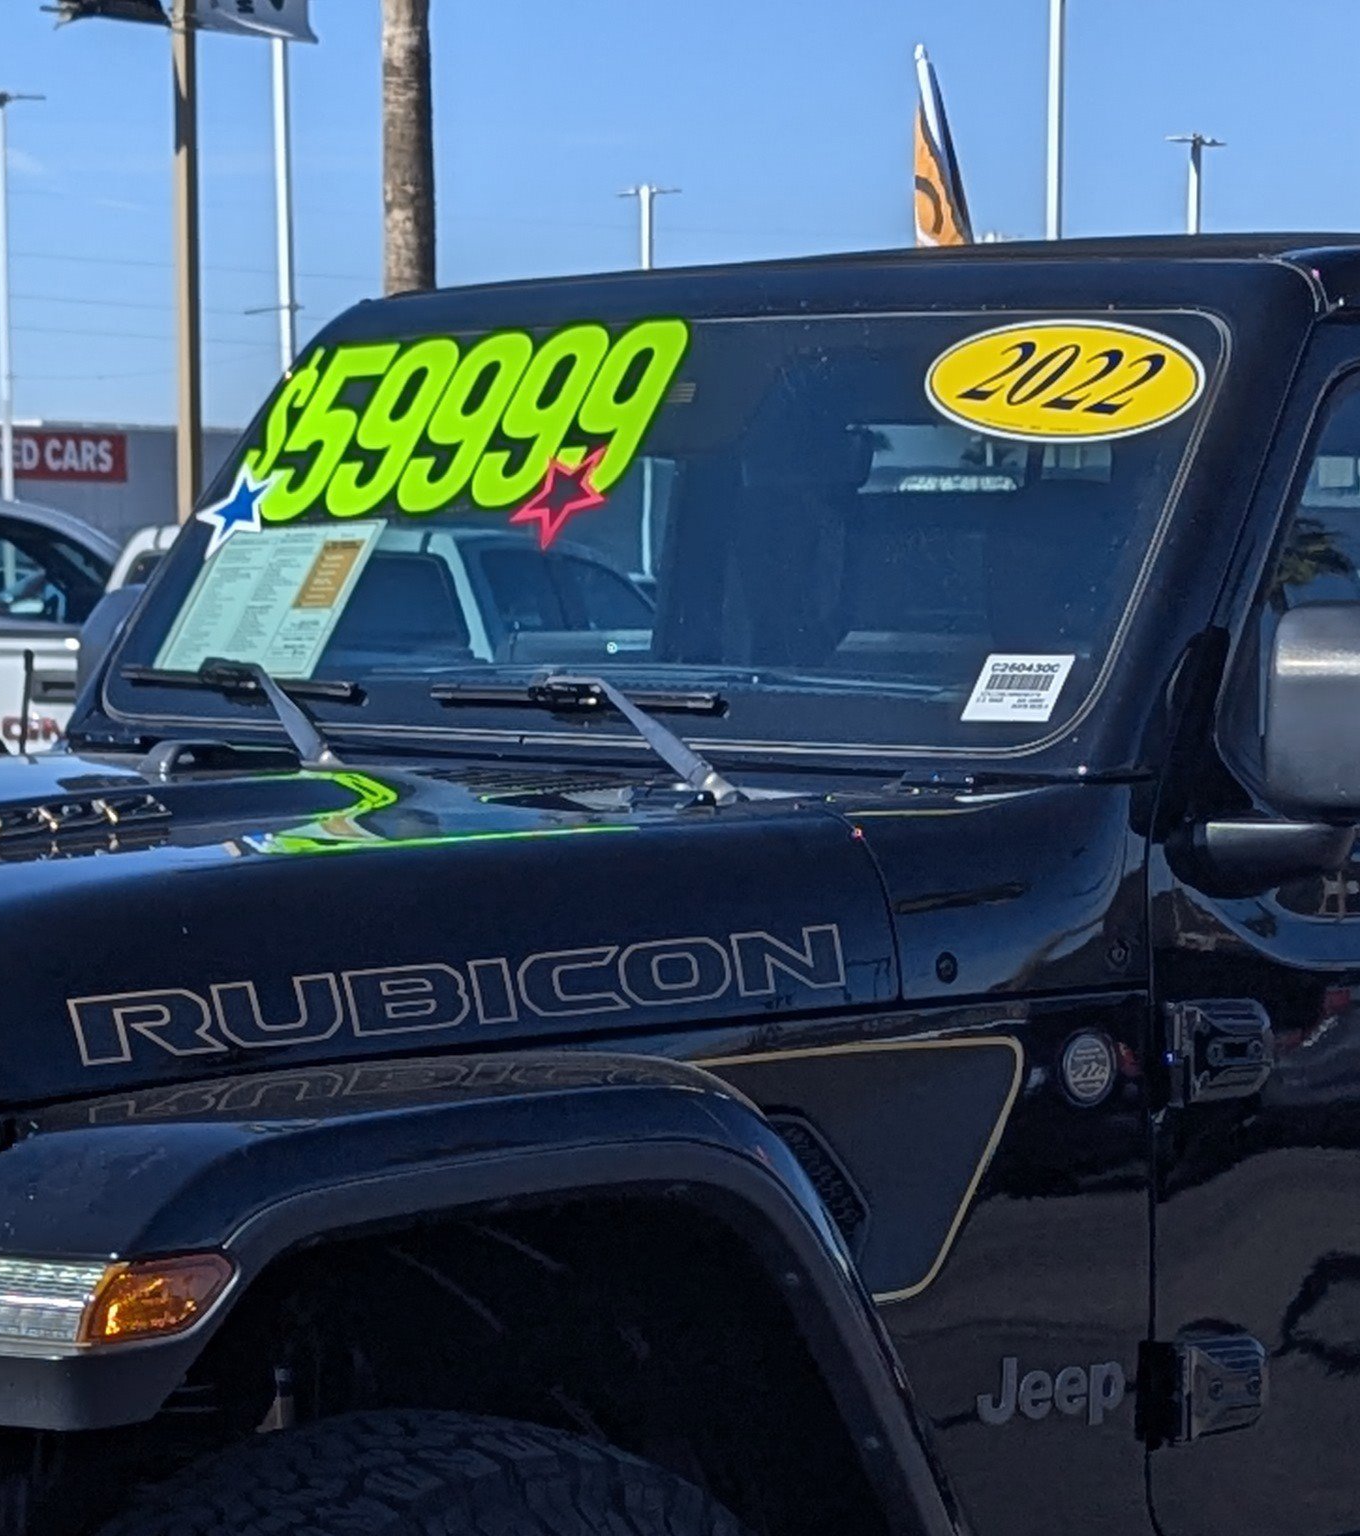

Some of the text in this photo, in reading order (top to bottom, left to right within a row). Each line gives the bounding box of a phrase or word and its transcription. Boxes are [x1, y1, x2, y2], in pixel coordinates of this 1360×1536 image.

[955, 341, 1166, 416] 2022
[45, 439, 113, 474] CARS
[242, 318, 690, 523] $59999
[67, 924, 847, 1066] RUBICON
[976, 1356, 1127, 1427] Jeep
